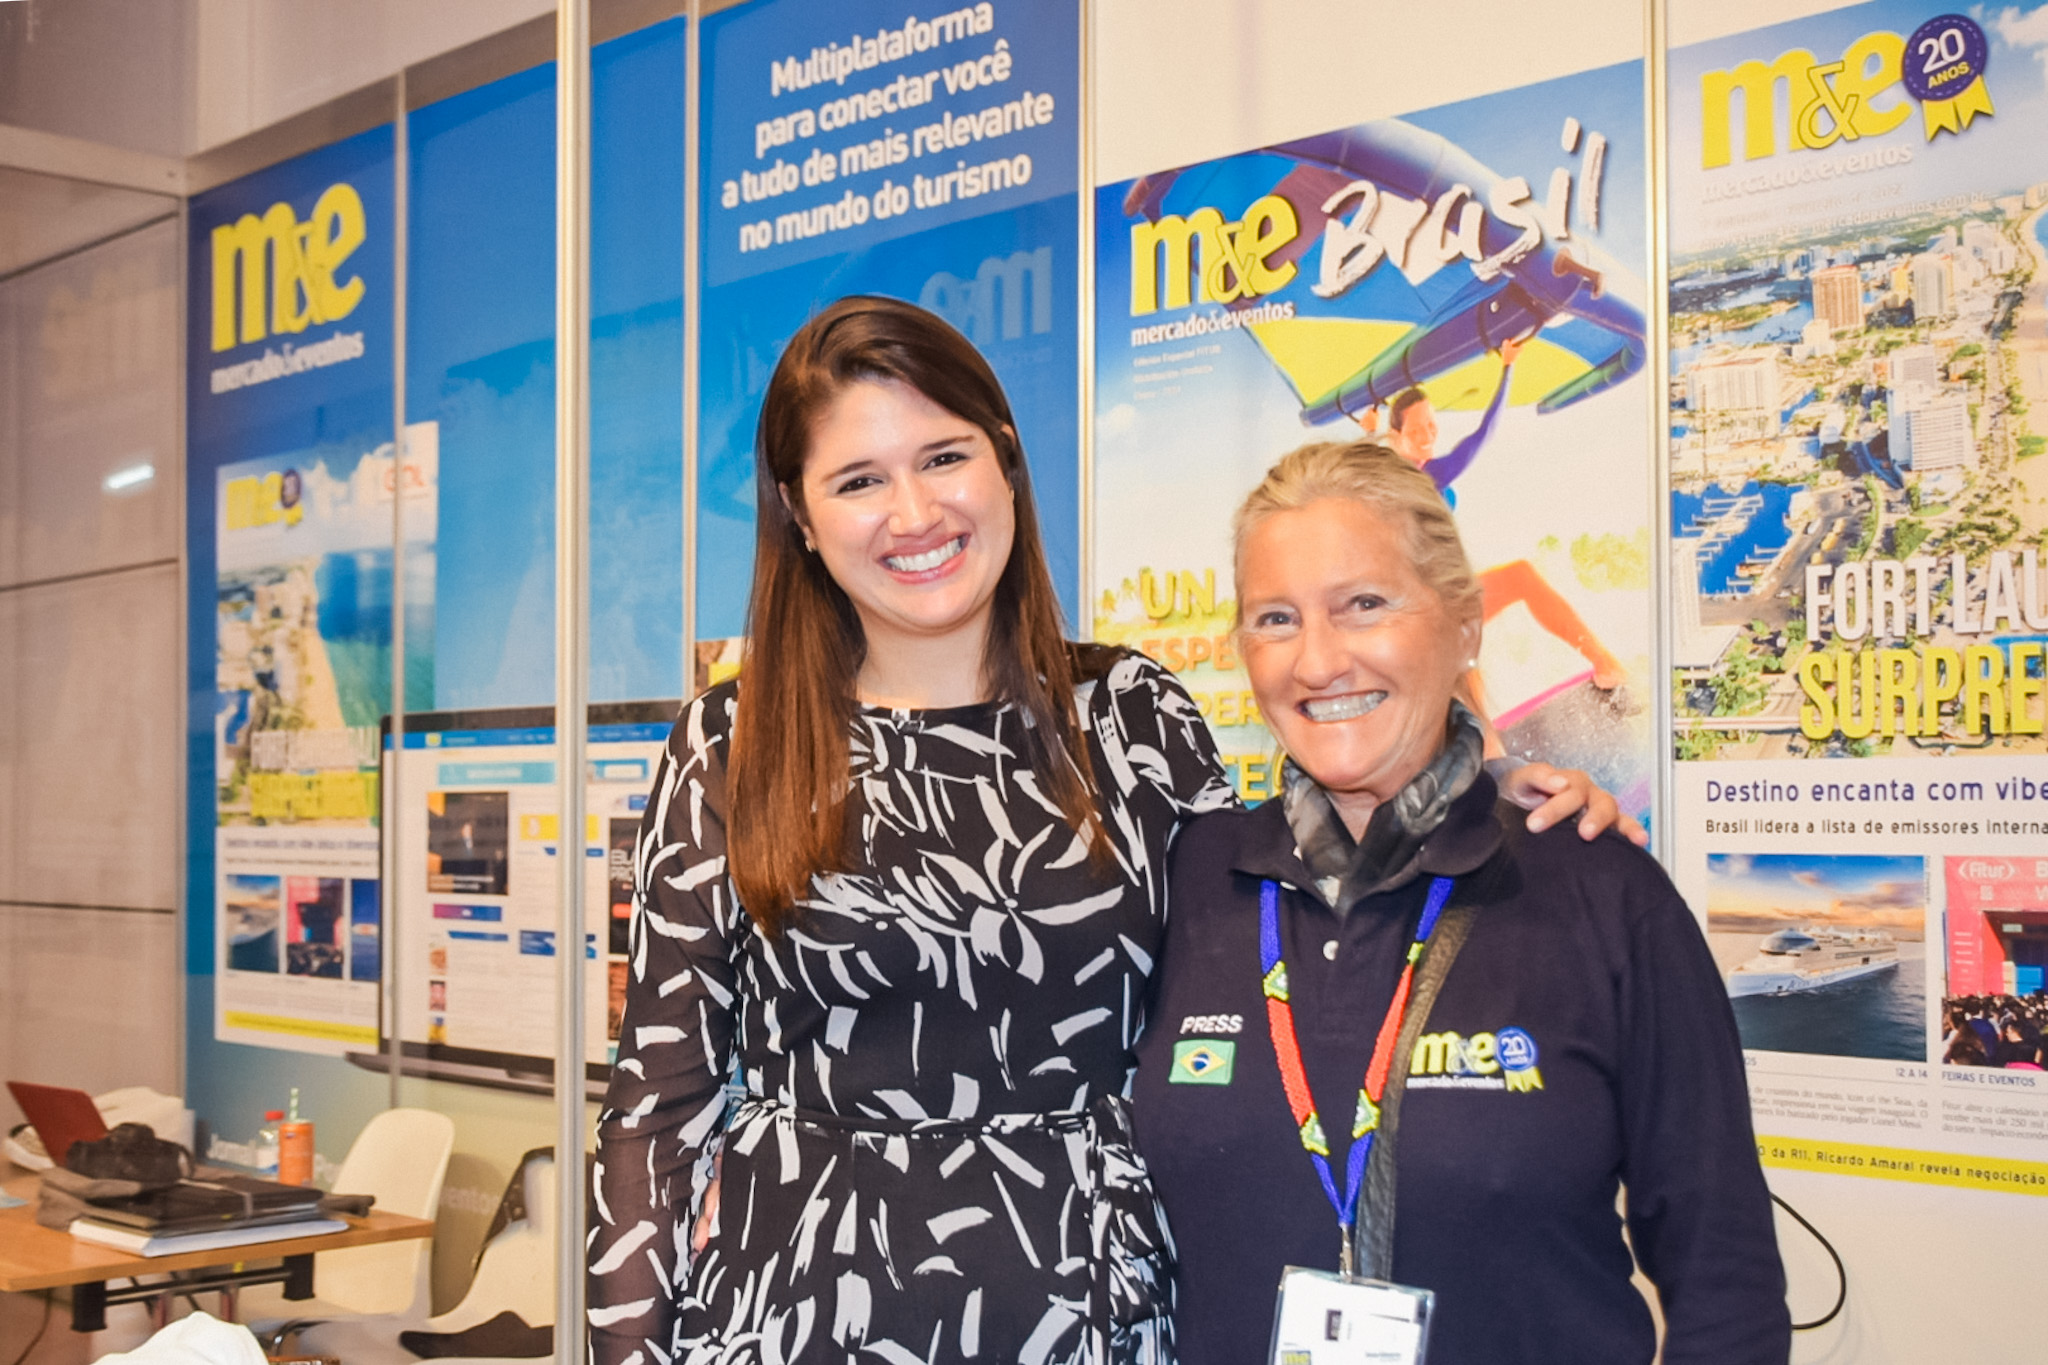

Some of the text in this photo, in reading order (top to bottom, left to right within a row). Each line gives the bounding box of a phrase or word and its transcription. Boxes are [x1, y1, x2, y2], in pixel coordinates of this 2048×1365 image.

[771, 2, 994, 97] Multiplataforma
[1918, 28, 1966, 74] 20
[1928, 61, 1970, 89] ANOS
[756, 38, 1012, 159] para conectar você
[1700, 30, 1913, 171] m&e
[722, 91, 1055, 209] a tudo de mais relevante
[739, 153, 1032, 253] no mundo do turismo
[1311, 116, 1606, 297] Brasil
[210, 182, 366, 353] m&e
[1130, 195, 1298, 317] m&e
[1131, 301, 1296, 348] mercado&eventos
[1140, 567, 1215, 620] UN
[1804, 549, 2048, 642] FORT LAU
[1142, 633, 1236, 673] ESPE
[1798, 642, 2048, 740] SURPRE
[1706, 776, 2048, 802] Destino encanta com vibe
[1705, 819, 1749, 834] Brasil
[1754, 819, 1799, 834] lidera
[1806, 822, 1814, 834] a
[1821, 819, 1856, 834] lista
[1863, 819, 1883, 834] de
[1891, 820, 1979, 834] emissores
[1179, 1014, 1243, 1034] PRESS
[1410, 1031, 1527, 1075] m&e 20
[1942, 1071, 2036, 1087] FEIRAS E EVENTOS
[1771, 1148, 1785, 1159] da
[1817, 1151, 1864, 1166] Ricardo
[1870, 1157, 1914, 1171] Amaral
[1920, 1163, 1960, 1176] revela
[1967, 1167, 2046, 1185] negociação
